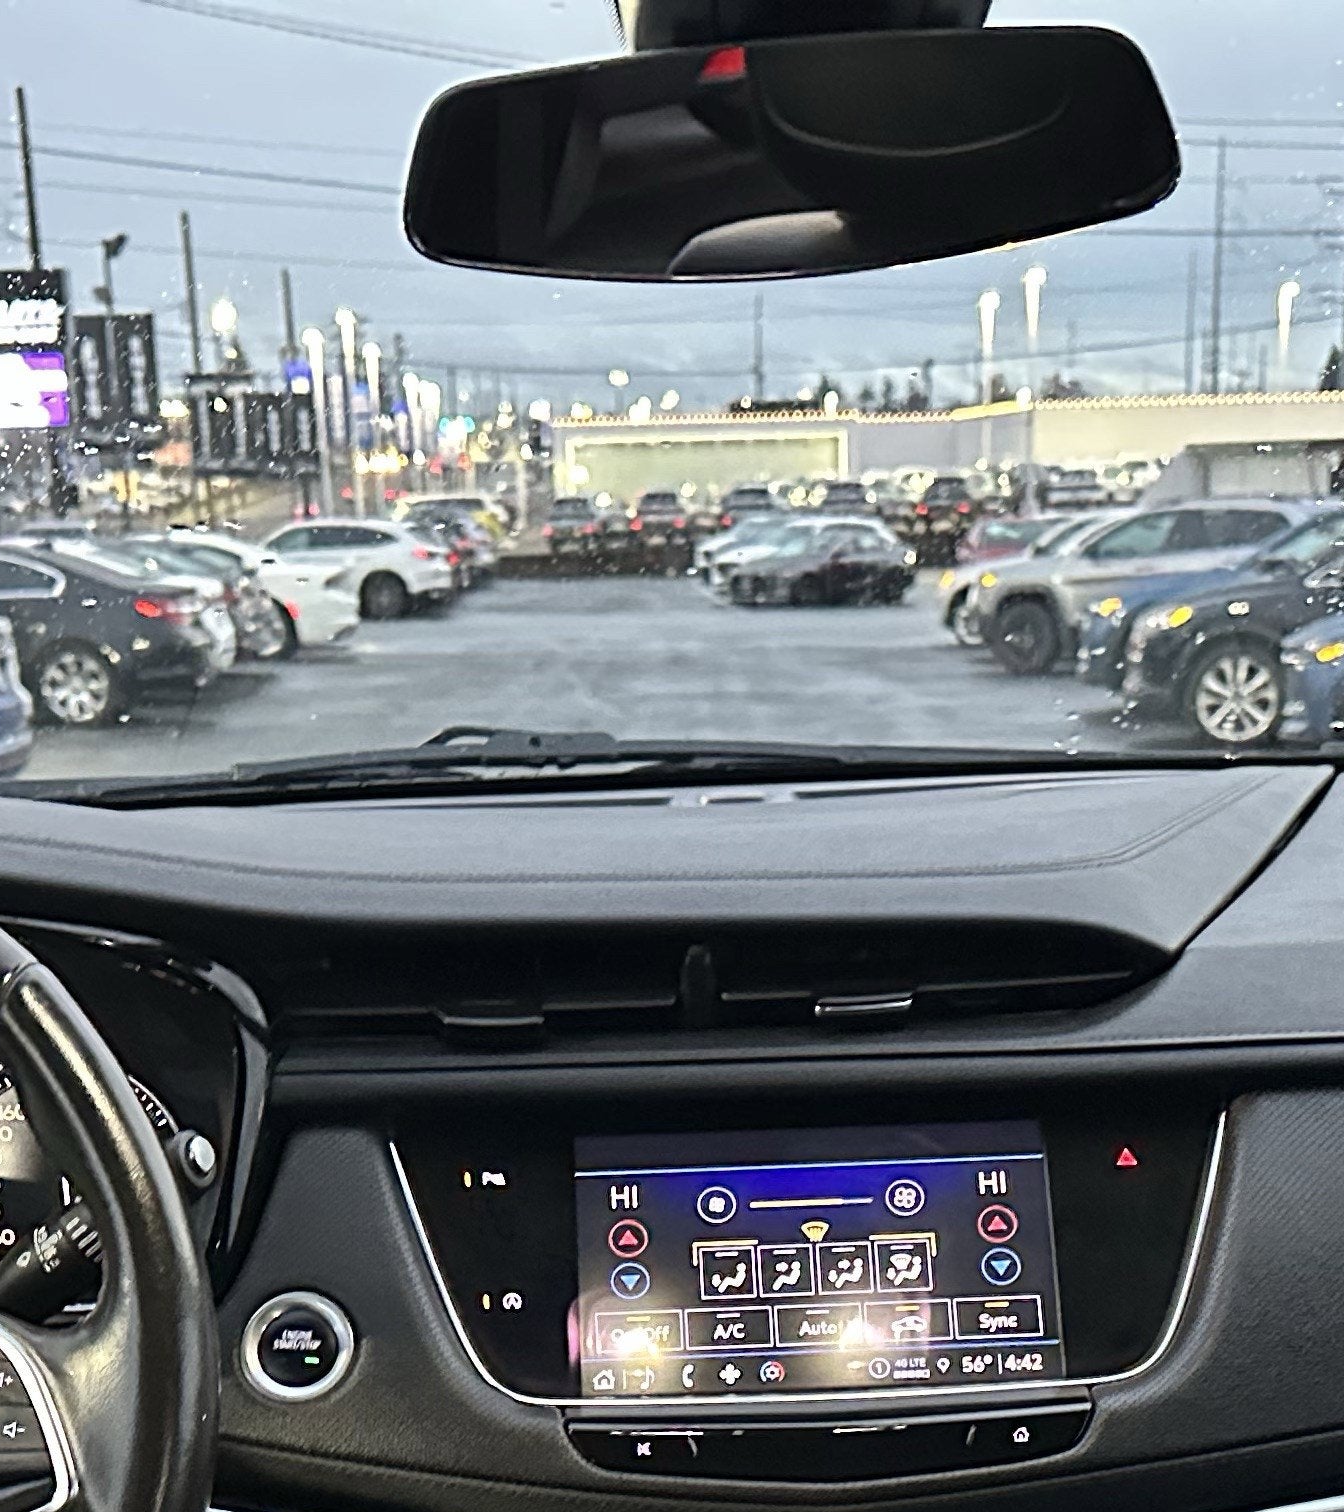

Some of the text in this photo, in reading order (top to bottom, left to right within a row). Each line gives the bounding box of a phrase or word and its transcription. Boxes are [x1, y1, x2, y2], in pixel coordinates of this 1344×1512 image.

[978, 1170, 1007, 1195] HI
[610, 1185, 638, 1209] HI
[799, 1321, 838, 1336] Auto
[978, 1313, 1018, 1329] Sync
[713, 1322, 745, 1339] A/C
[1004, 1353, 1043, 1371] 4:42
